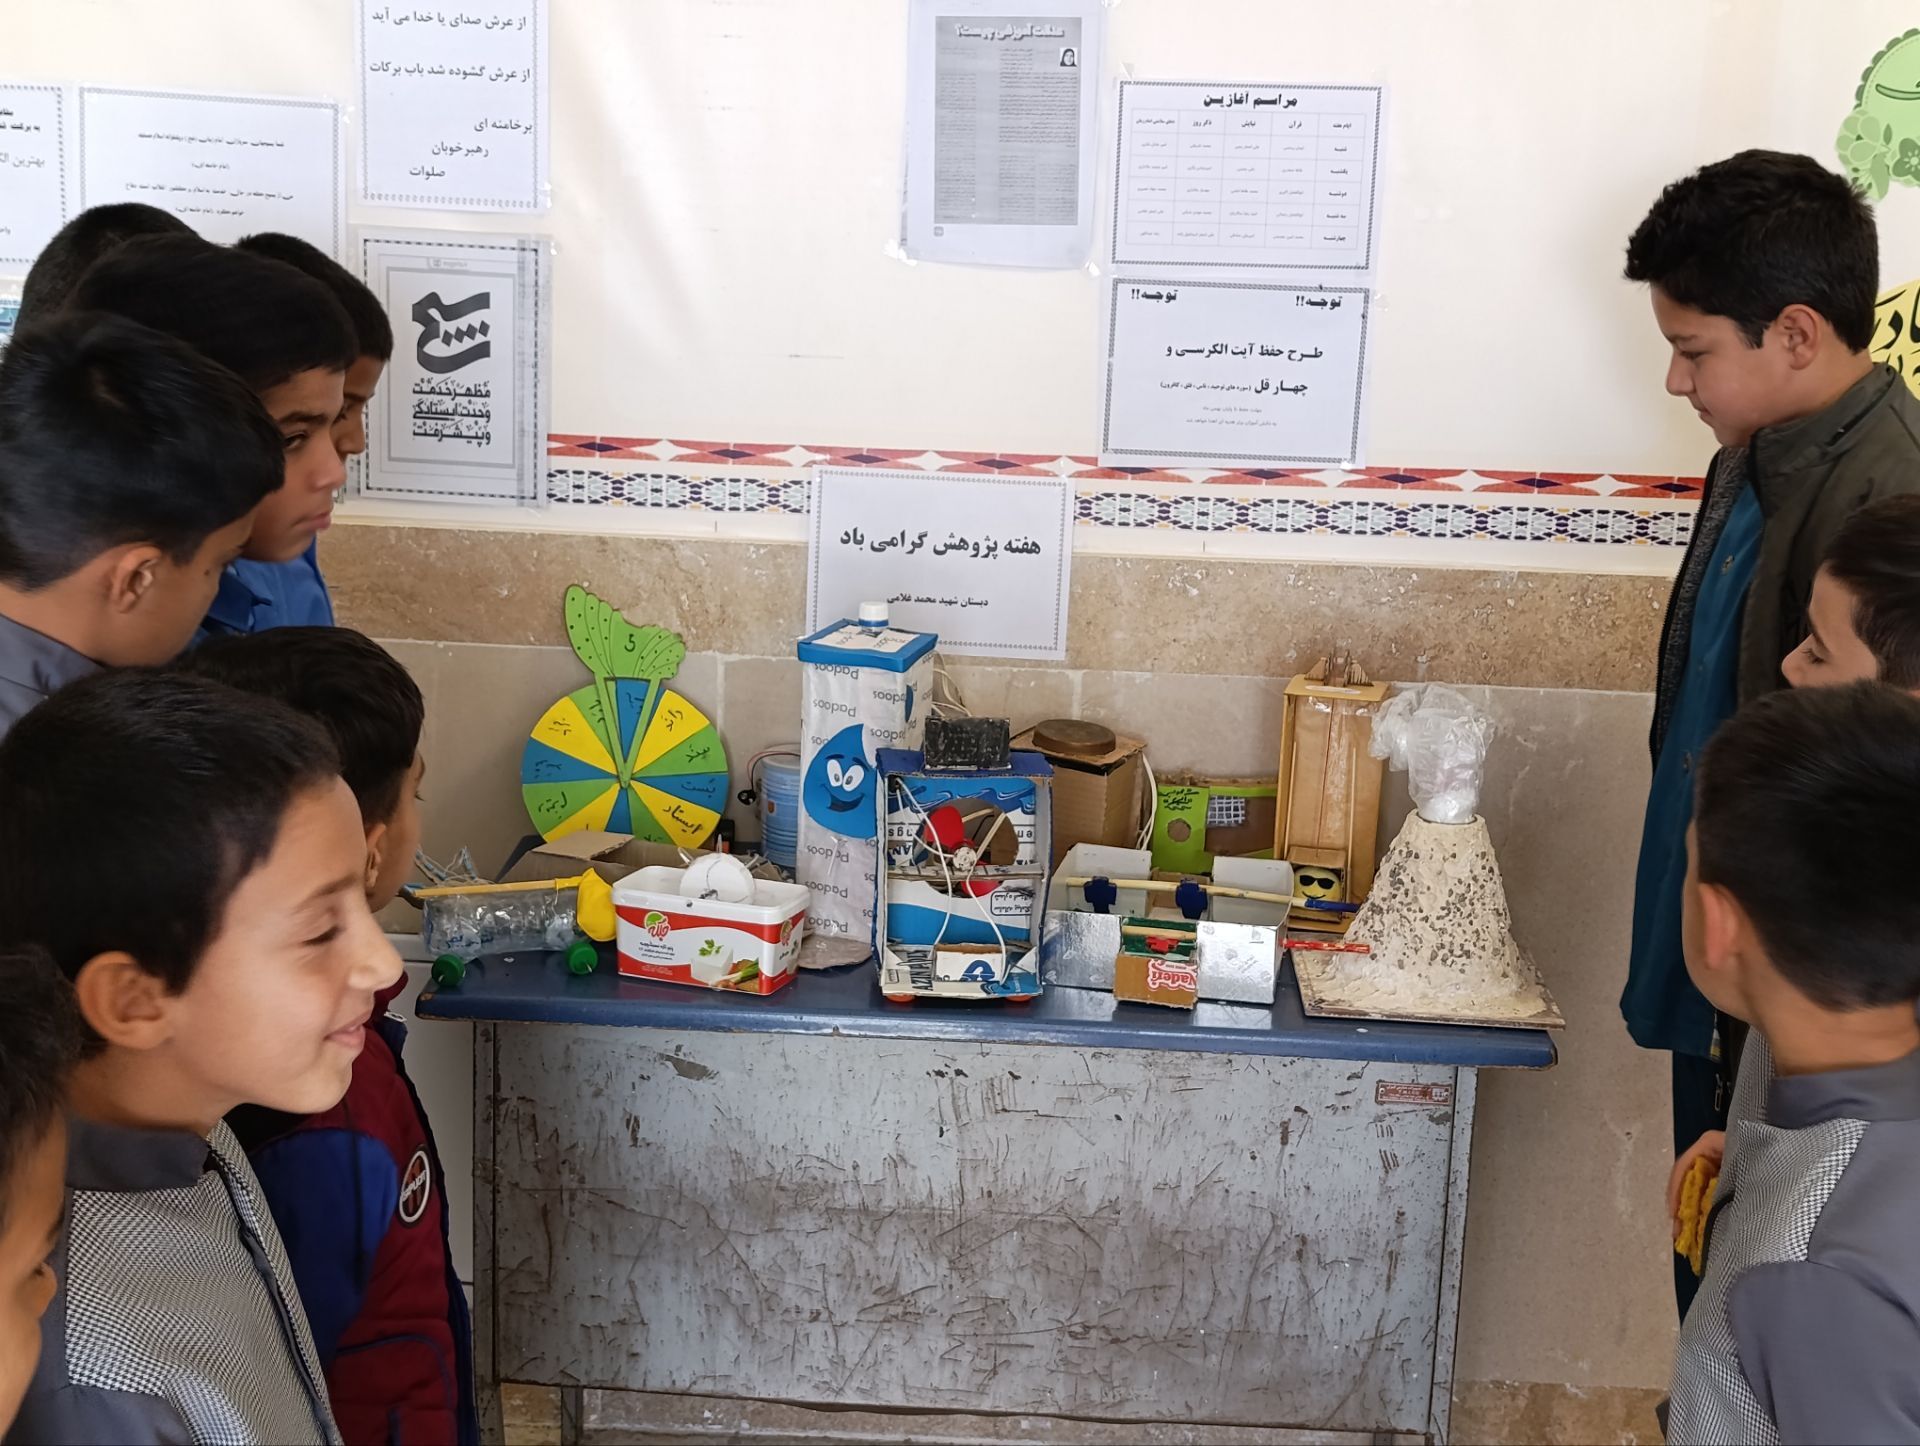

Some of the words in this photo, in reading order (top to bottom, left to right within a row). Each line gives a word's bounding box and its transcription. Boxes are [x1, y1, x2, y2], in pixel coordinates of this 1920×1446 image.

[372, 7, 389, 23] آید
[393, 14, 410, 25] می
[413, 11, 433, 22] خدا
[450, 13, 482, 27] صدای
[485, 15, 514, 30] عرش
[517, 16, 527, 30] از
[369, 61, 402, 77] برکات
[404, 63, 424, 77] باب
[427, 64, 446, 75] شد
[449, 65, 485, 80] گشوده
[489, 67, 517, 81] عرش
[521, 68, 530, 82] از
[1203, 90, 1250, 108] آغازین
[1252, 92, 1298, 108] مراسم
[409, 165, 446, 180] صلوات
[1165, 345, 1173, 357] و
[1175, 343, 1228, 358] الکرسی
[1231, 342, 1256, 359] آیت
[1258, 344, 1284, 357] حفظ
[1287, 347, 1324, 362] طرح
[1254, 377, 1271, 394] قل
[1273, 379, 1309, 396] چهار
[840, 526, 865, 550] باد
[870, 529, 928, 554] گرامی
[933, 531, 998, 560] پژوهش
[1003, 535, 1041, 555] هفته
[886, 592, 912, 604] غلامی
[914, 595, 937, 604] محمد
[939, 596, 958, 606] شهید
[960, 596, 988, 608] دبستان
[808, 916, 849, 933] Pdoo
